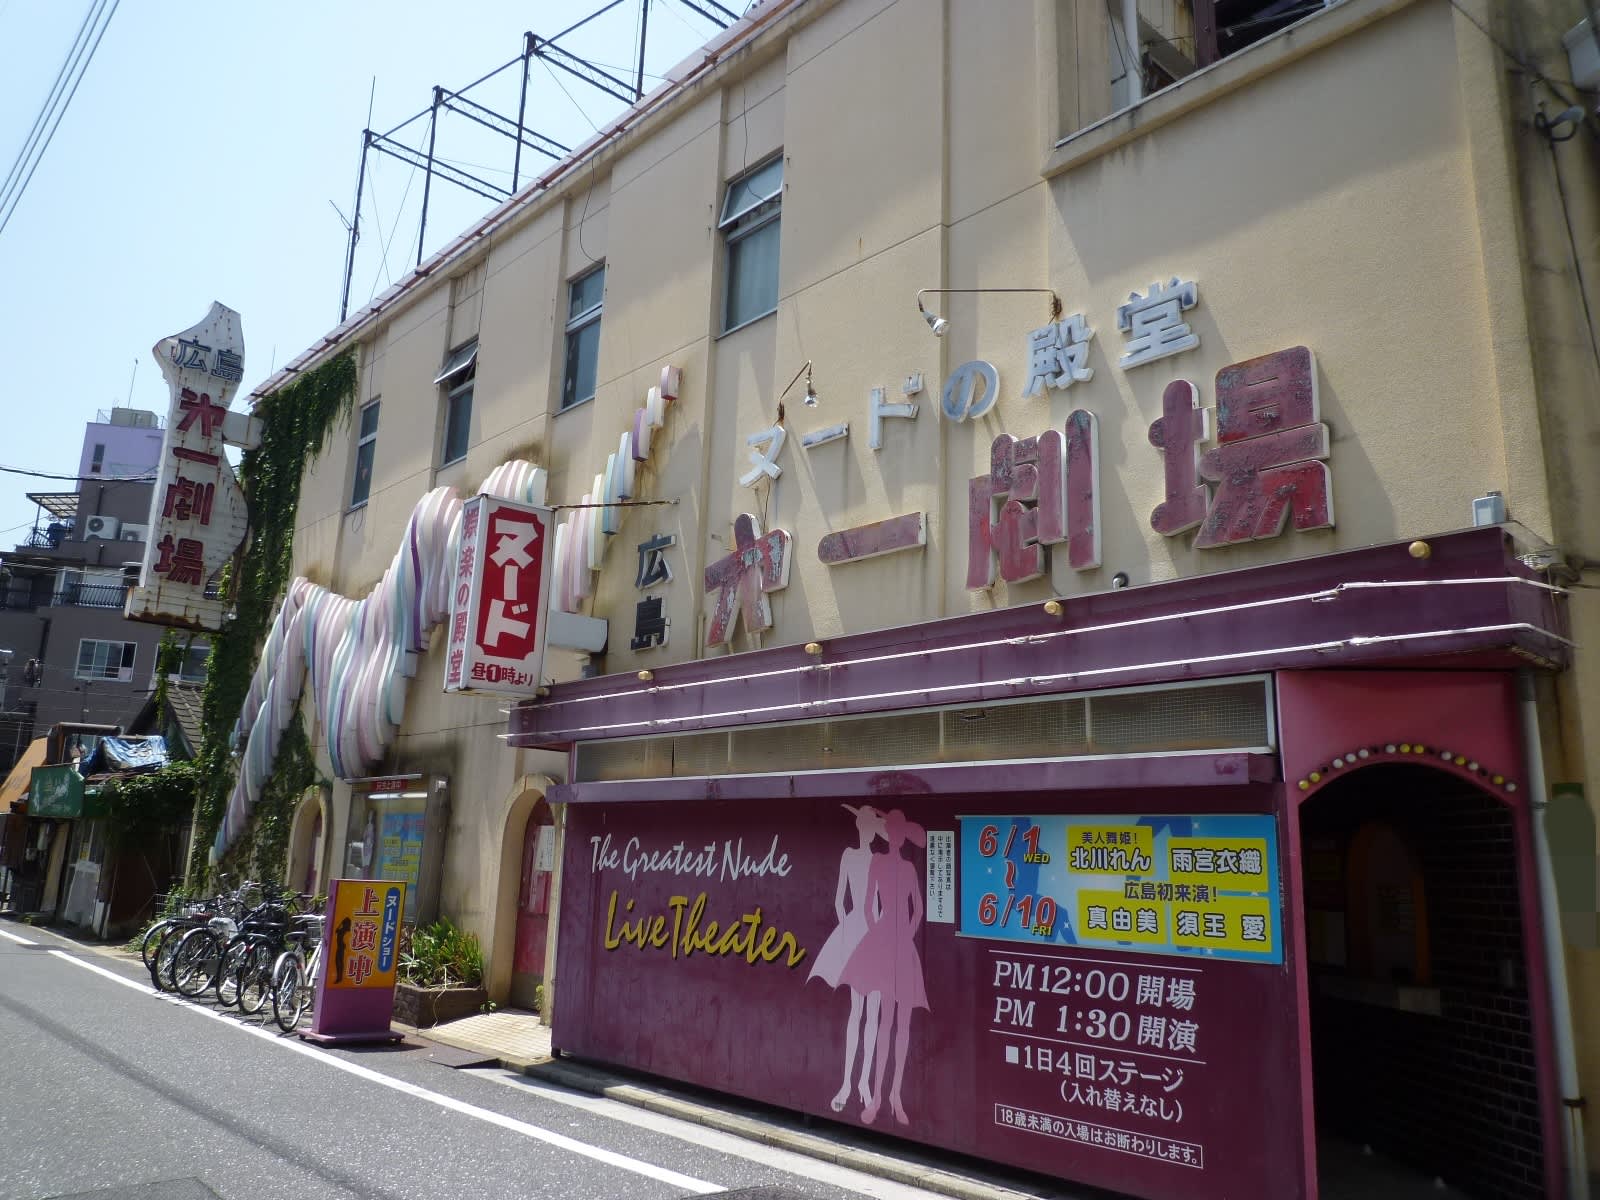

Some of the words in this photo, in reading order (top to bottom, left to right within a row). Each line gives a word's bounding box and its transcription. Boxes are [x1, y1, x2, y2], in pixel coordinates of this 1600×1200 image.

[174, 336, 244, 383] 広島
[738, 276, 1200, 489] ヌードの殿堂
[482, 518, 539, 648] ヌード
[630, 533, 677, 652] 広島
[590, 833, 620, 873] The
[623, 836, 718, 881] Greatest
[720, 834, 793, 883] Nude
[978, 824, 1041, 857] 6/1
[1023, 853, 1051, 865] WED
[1070, 846, 1152, 872] 北川れん
[1170, 847, 1263, 874] 雨宮衣織
[978, 892, 1057, 929] 6/10
[1124, 881, 1217, 904] 広島初来演！
[347, 886, 380, 984] 上演中
[382, 895, 398, 968] ヌードショー
[1031, 926, 1053, 937] FRI
[1087, 905, 1159, 934] 真由美
[993, 960, 1035, 991] PM
[1039, 965, 1130, 1001] 12:00
[1136, 974, 1196, 1011] 開場
[993, 996, 1036, 1028] PM
[1056, 1005, 1131, 1042] 1:30
[1137, 1015, 1199, 1053] 開演
[1000, 1108, 1198, 1165] 18歳未満の入場はお断わりします。
